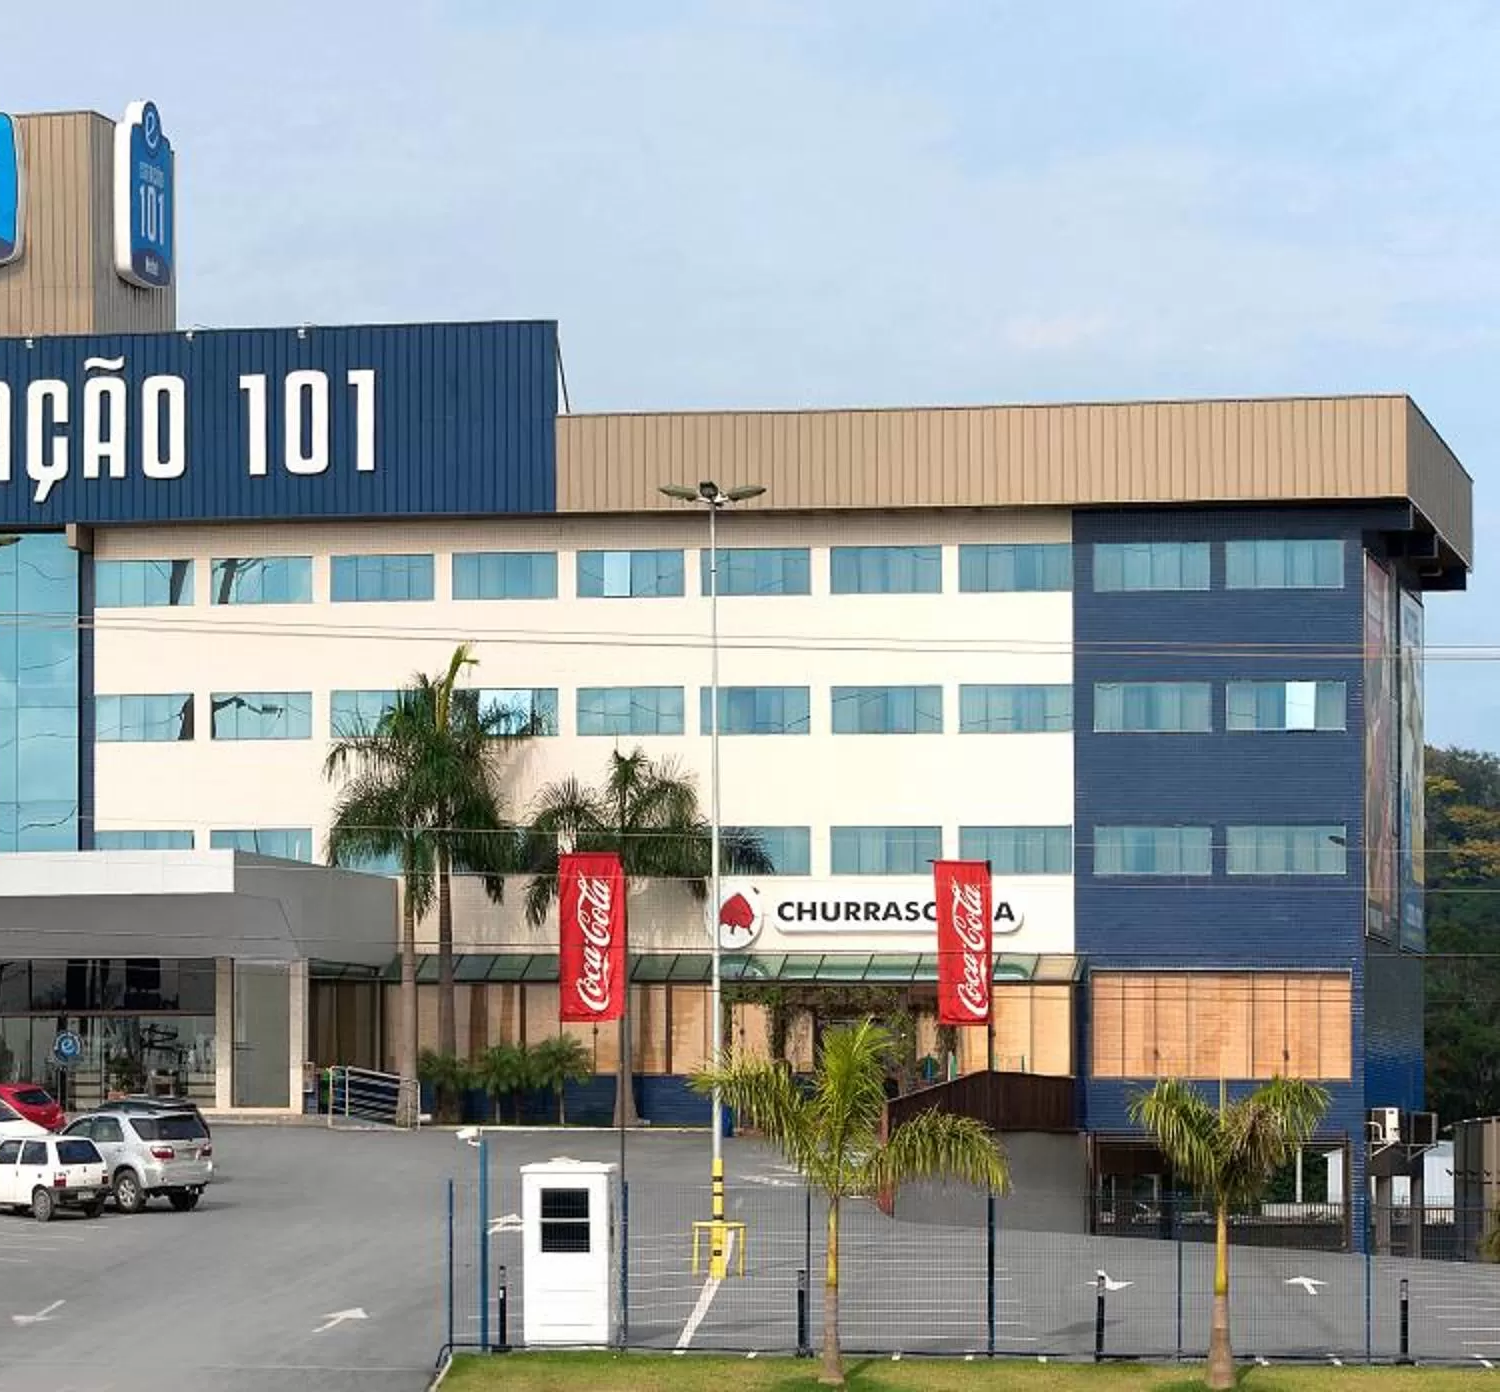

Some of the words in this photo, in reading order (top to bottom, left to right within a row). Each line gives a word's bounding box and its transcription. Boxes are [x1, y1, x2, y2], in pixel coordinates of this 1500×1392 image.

[140, 185, 164, 246] 101
[239, 369, 375, 476] 101
[777, 901, 1015, 922] CHURRASCA
